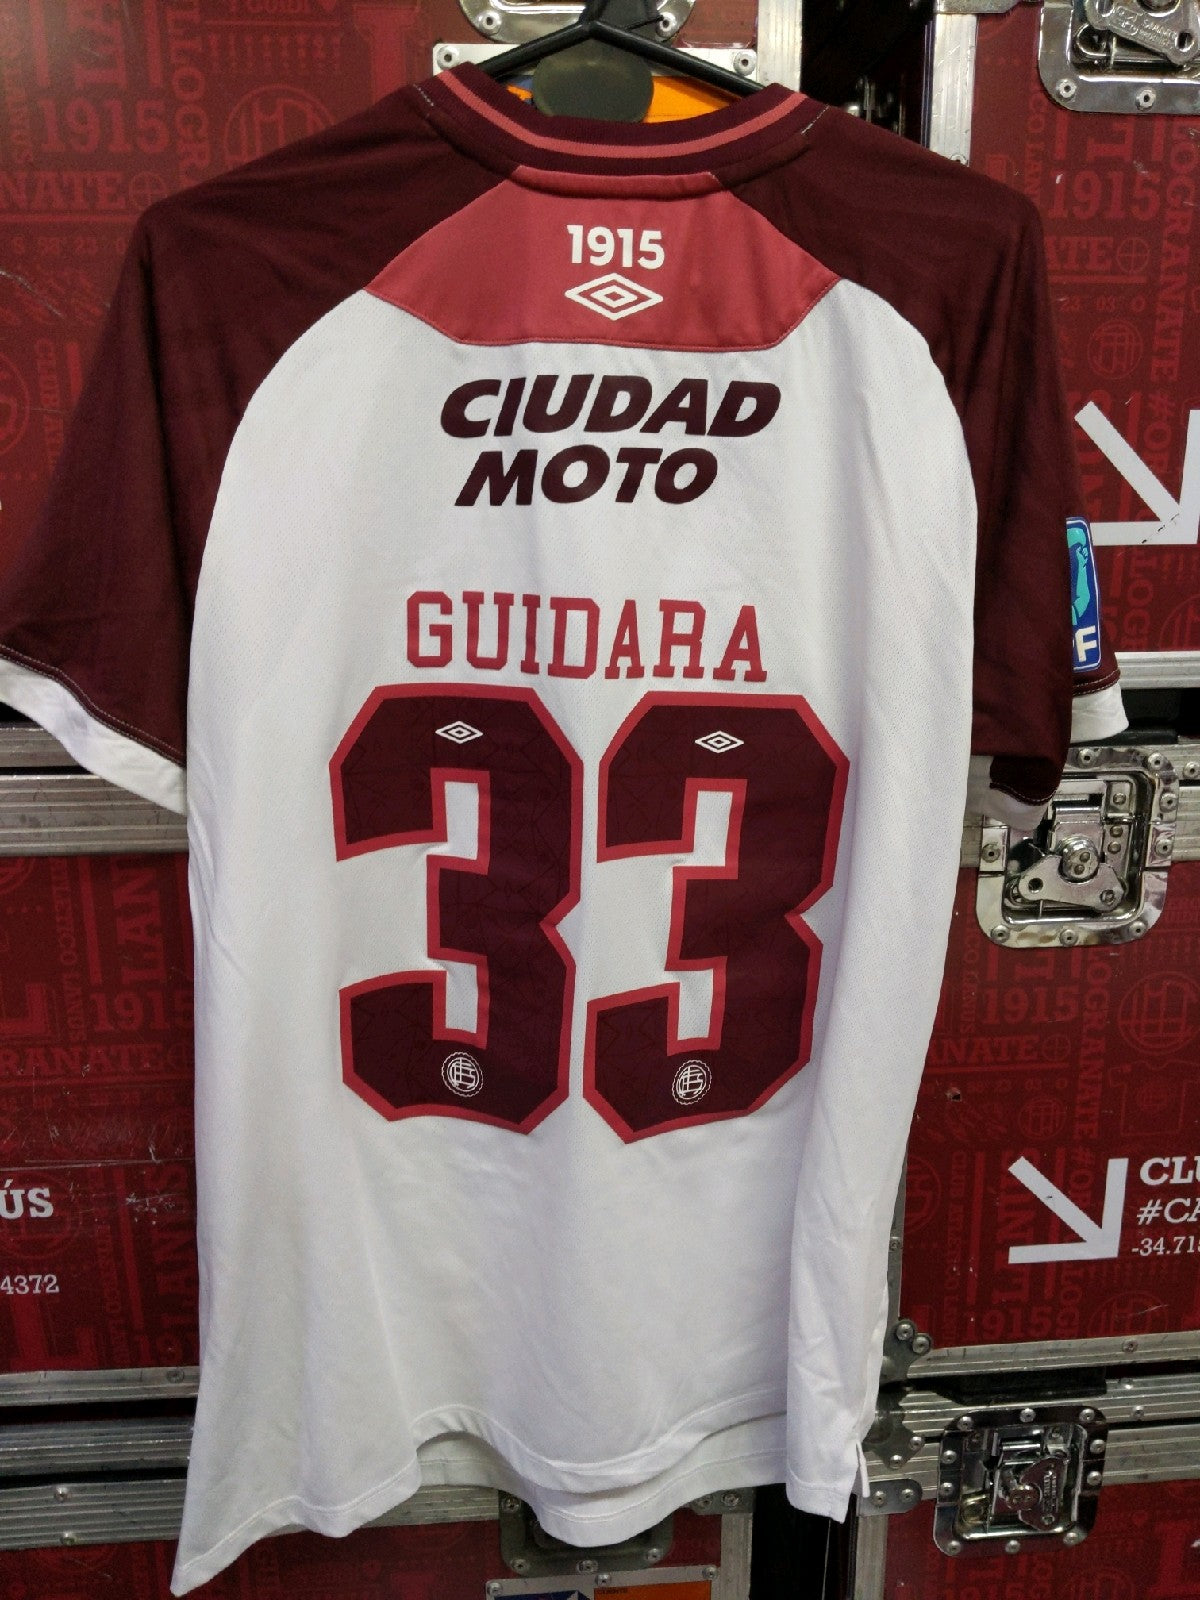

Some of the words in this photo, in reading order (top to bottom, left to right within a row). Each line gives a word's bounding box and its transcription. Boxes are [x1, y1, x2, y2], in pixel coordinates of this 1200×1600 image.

[39, 97, 170, 154] 1915
[1049, 169, 1160, 221] 1915
[566, 224, 666, 270] 1915
[440, 374, 782, 438] CIUDAD
[454, 444, 719, 507] MOTO
[405, 591, 768, 683] GUIDARA
[328, 682, 851, 1145] 33
[982, 985, 1080, 1026] 1915
[0, 1274, 60, 1294] 4372
